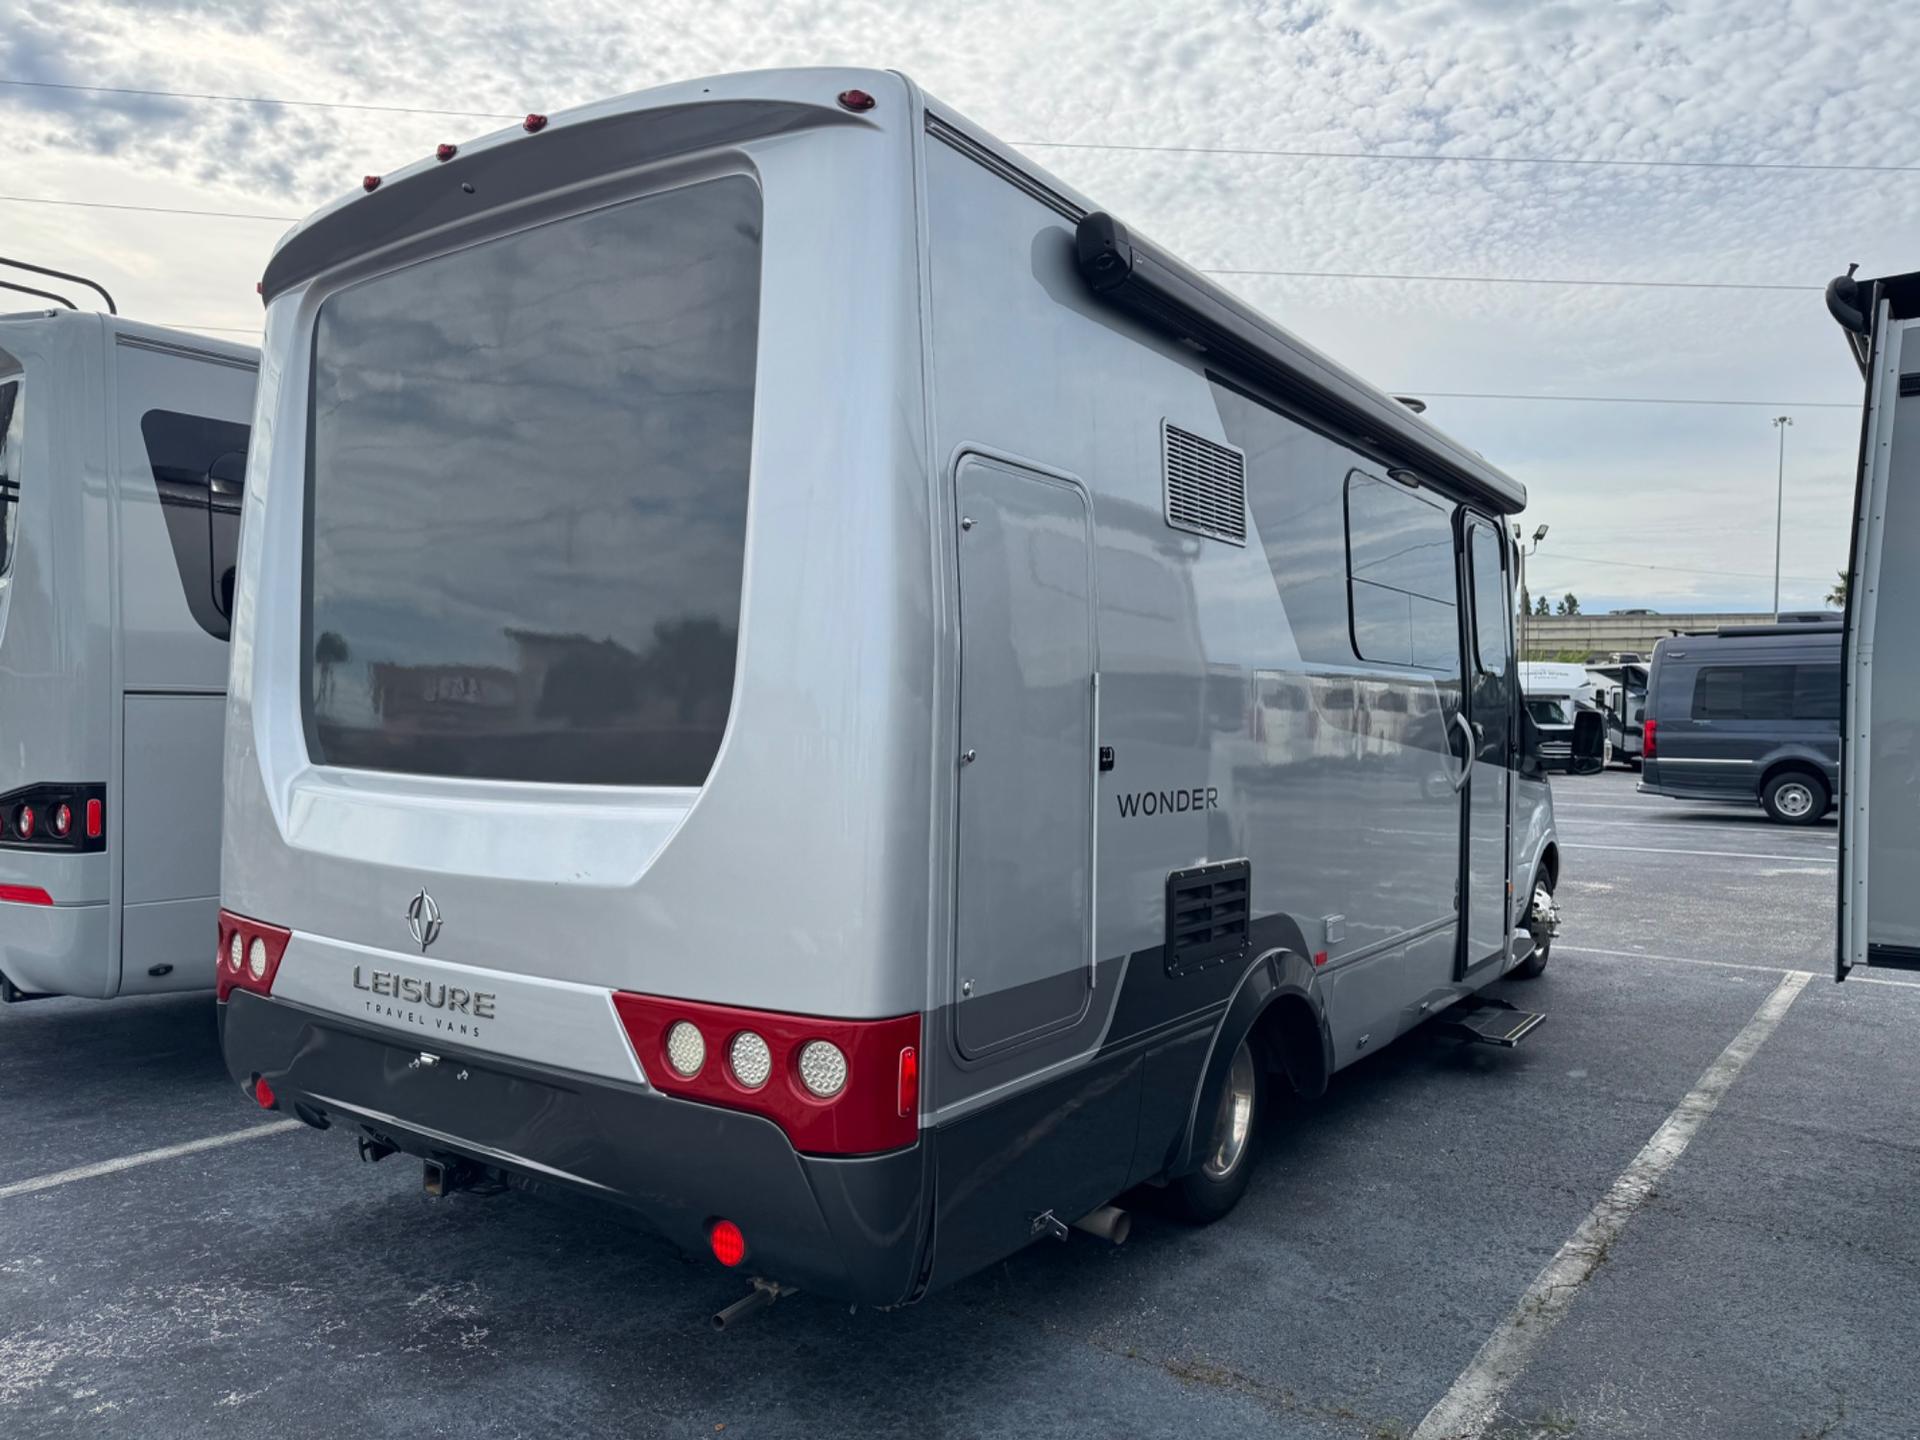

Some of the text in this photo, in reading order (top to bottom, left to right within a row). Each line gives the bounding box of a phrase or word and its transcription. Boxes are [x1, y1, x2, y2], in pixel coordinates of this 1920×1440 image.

[1117, 787, 1218, 818] WONDER
[353, 964, 496, 1020] LEISURE
[366, 1001, 480, 1038] TRAVEL VANS
